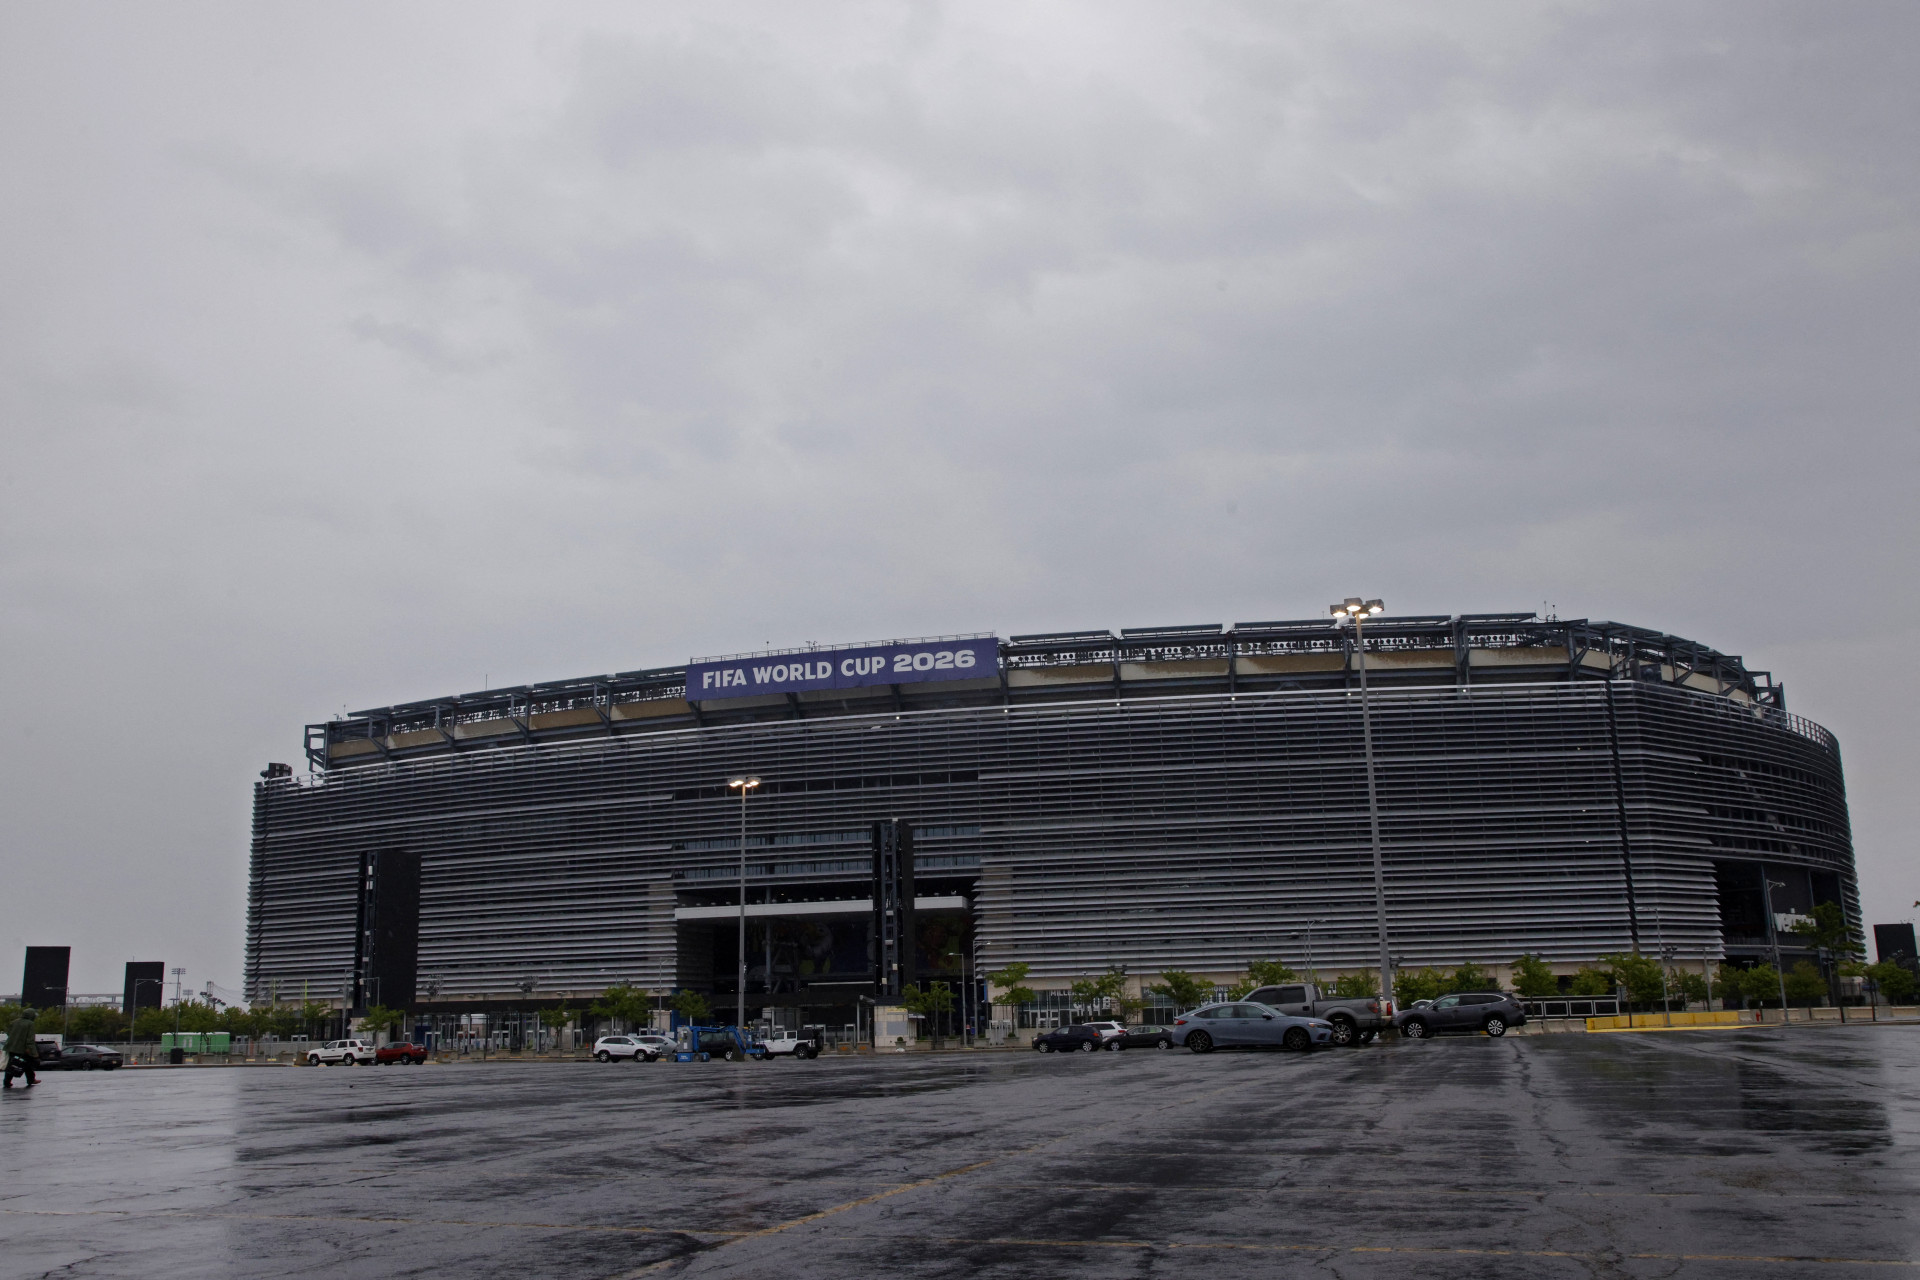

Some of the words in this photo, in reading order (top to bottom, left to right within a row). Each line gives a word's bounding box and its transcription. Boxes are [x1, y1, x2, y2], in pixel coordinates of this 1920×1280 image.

[702, 668, 747, 689] FIFA
[752, 661, 832, 684] WORLD
[840, 656, 886, 677] CUP
[893, 649, 976, 672] 2026
